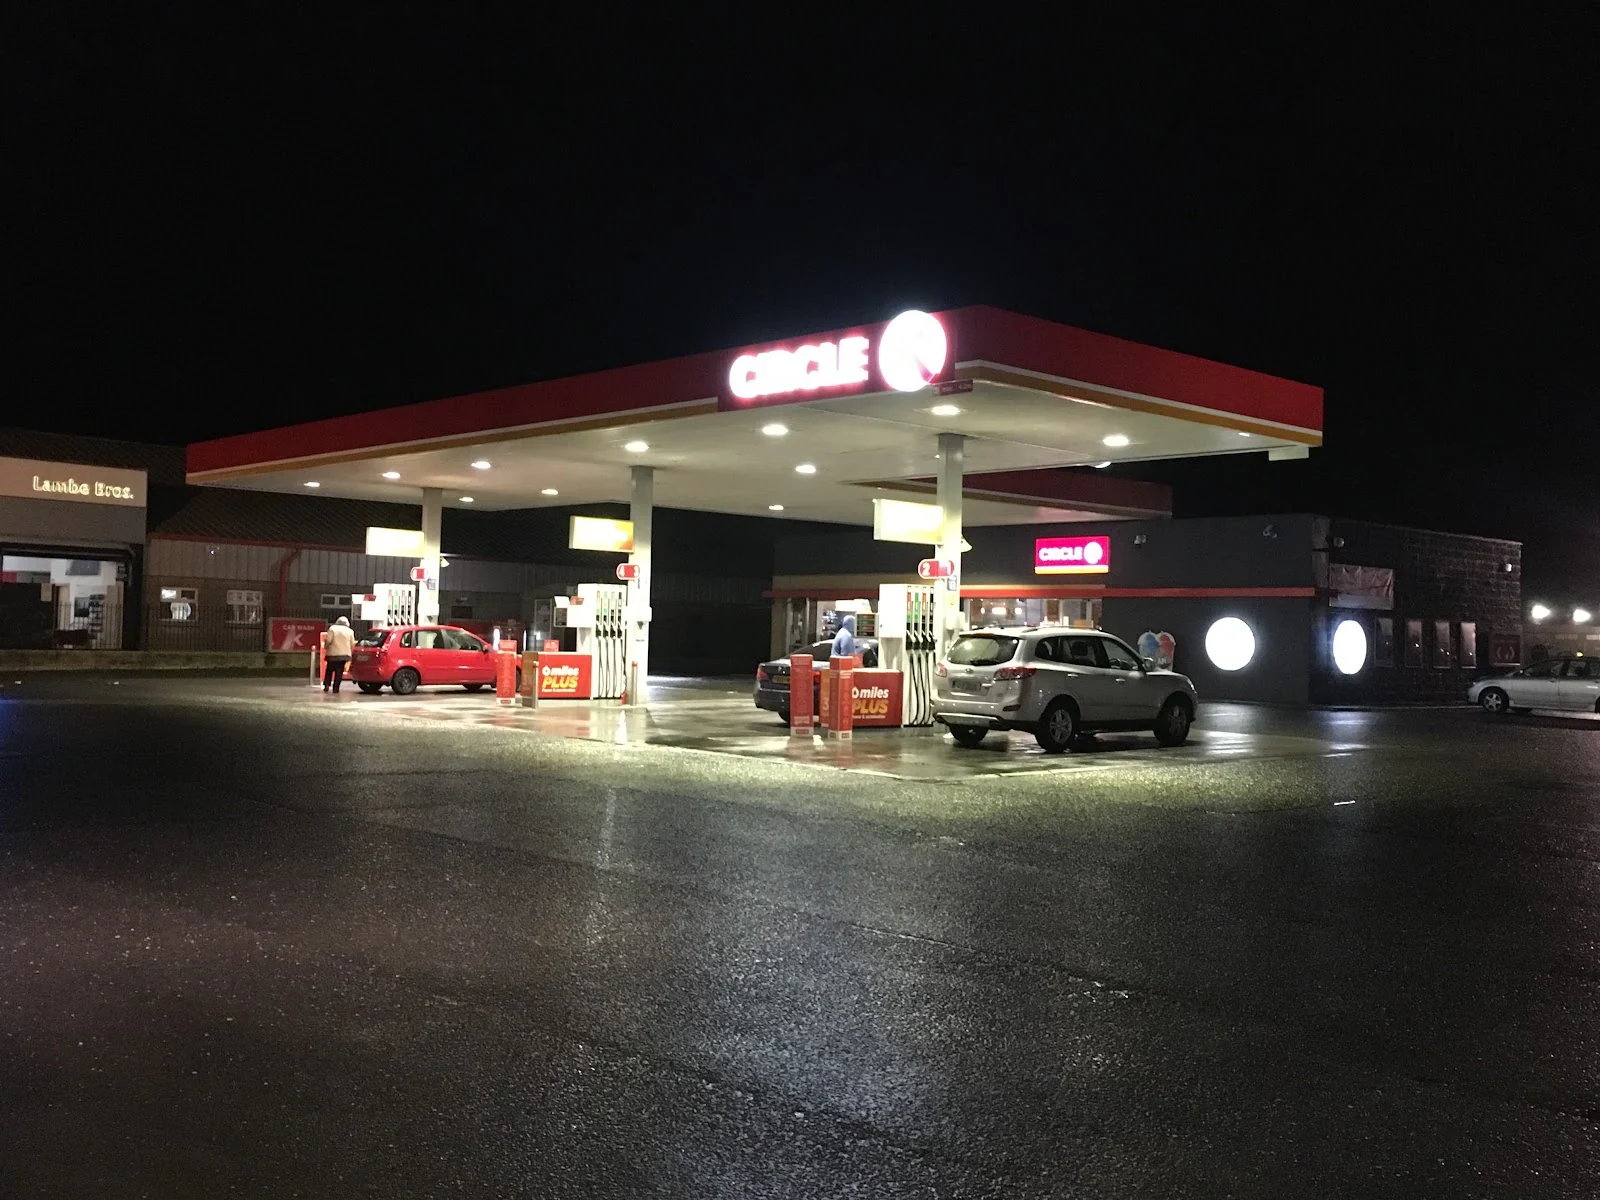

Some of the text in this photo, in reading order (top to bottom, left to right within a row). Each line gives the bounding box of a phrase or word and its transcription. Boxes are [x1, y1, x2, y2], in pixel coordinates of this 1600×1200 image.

[729, 336, 869, 398] CIRCLE
[32, 475, 135, 499] Lambe Bros.
[1038, 546, 1083, 561] CIRCLE
[921, 562, 931, 576] 2
[542, 675, 579, 689] PLUS
[859, 686, 889, 698] miles
[852, 699, 889, 714] PLUS
